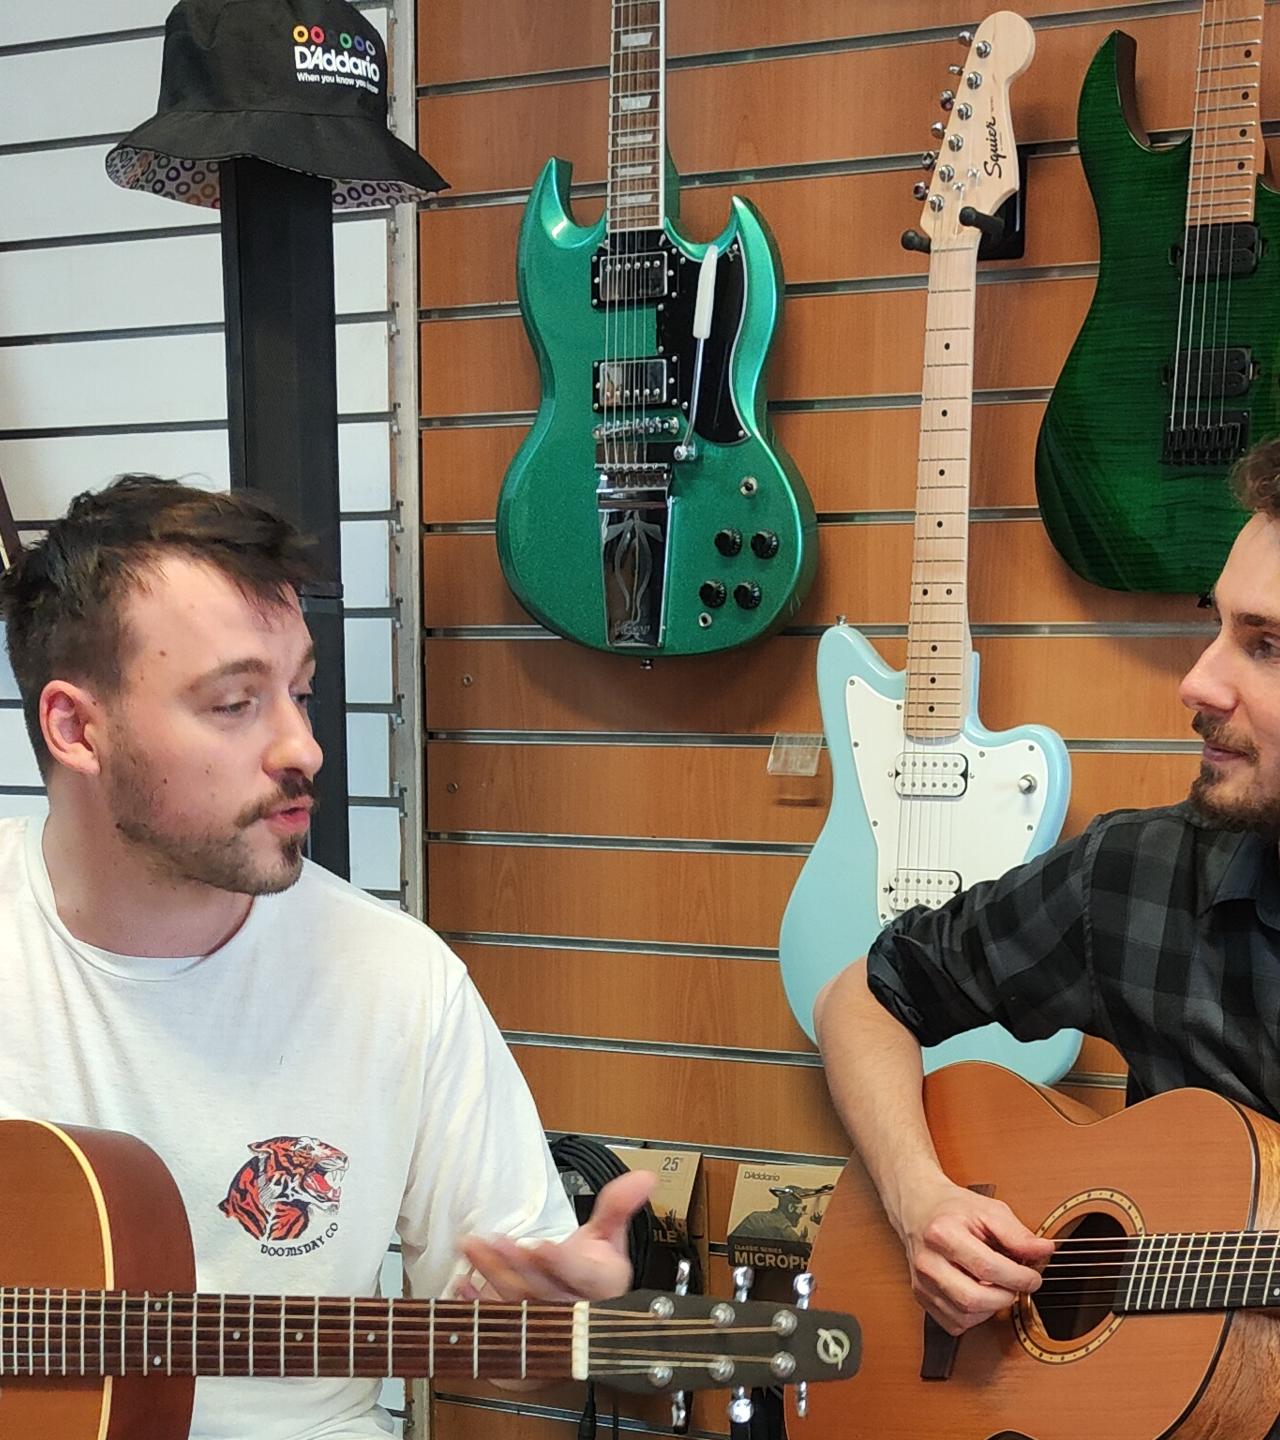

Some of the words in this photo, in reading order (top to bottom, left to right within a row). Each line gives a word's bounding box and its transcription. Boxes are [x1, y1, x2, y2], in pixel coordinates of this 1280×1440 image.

[294, 45, 380, 82] D'Addario
[296, 71, 320, 83] When
[321, 74, 335, 85] you
[336, 75, 355, 86] know
[983, 116, 1007, 180] Squier
[743, 1171, 781, 1182] D'Addario
[260, 1235, 325, 1257] DOOMSDAY
[325, 1222, 339, 1239] CO
[734, 1251, 808, 1270] MICROPH
